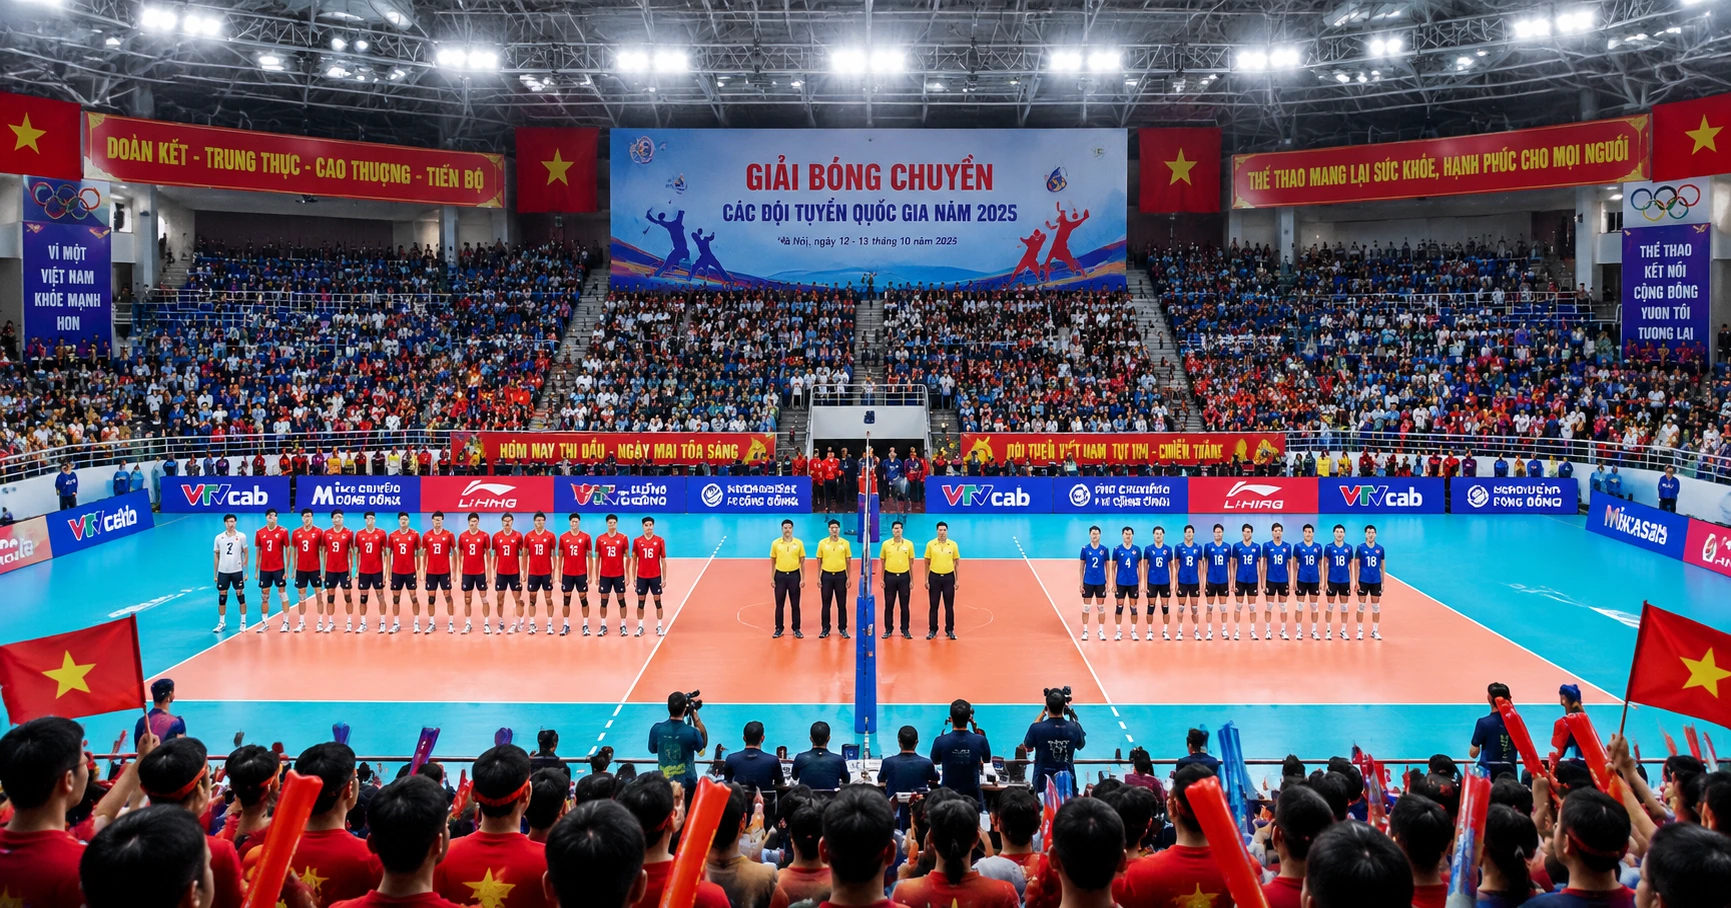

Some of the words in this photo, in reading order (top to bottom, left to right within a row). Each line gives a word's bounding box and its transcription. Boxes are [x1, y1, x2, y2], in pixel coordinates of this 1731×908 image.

[107, 134, 152, 162] DOÀN
[204, 146, 256, 172] TRUNG
[316, 157, 346, 179] CAO
[746, 154, 798, 191] GIẢI
[809, 156, 881, 191] BÓNG
[1274, 168, 1306, 188] THAO
[1310, 165, 1347, 186] MANG
[1351, 164, 1370, 187] LẠI
[1444, 154, 1479, 180] HẠNH
[1484, 147, 1516, 174] PHÚC
[1522, 148, 1548, 170] CHO
[1553, 144, 1580, 170] MỌI
[722, 200, 756, 222] CÁC
[902, 204, 928, 222] GIA
[977, 204, 1018, 222] 2025
[840, 236, 850, 246] 12
[859, 236, 868, 246] 13
[900, 236, 910, 246] 10
[936, 236, 958, 246] 2025
[1664, 244, 1692, 258] THAO
[69, 270, 94, 284] NAM
[68, 292, 100, 311] MẠNH
[1677, 327, 1694, 340] LAI
[532, 443, 554, 458] NAY
[559, 444, 577, 458] THI
[654, 444, 676, 458] MAI
[643, 548, 654, 558] 16
[1274, 554, 1283, 564] 18
[1092, 557, 1098, 568] 2
[1125, 558, 1130, 568] 4
[1304, 555, 1314, 565] 18
[1336, 556, 1346, 566] 18
[1366, 556, 1376, 567] 18
